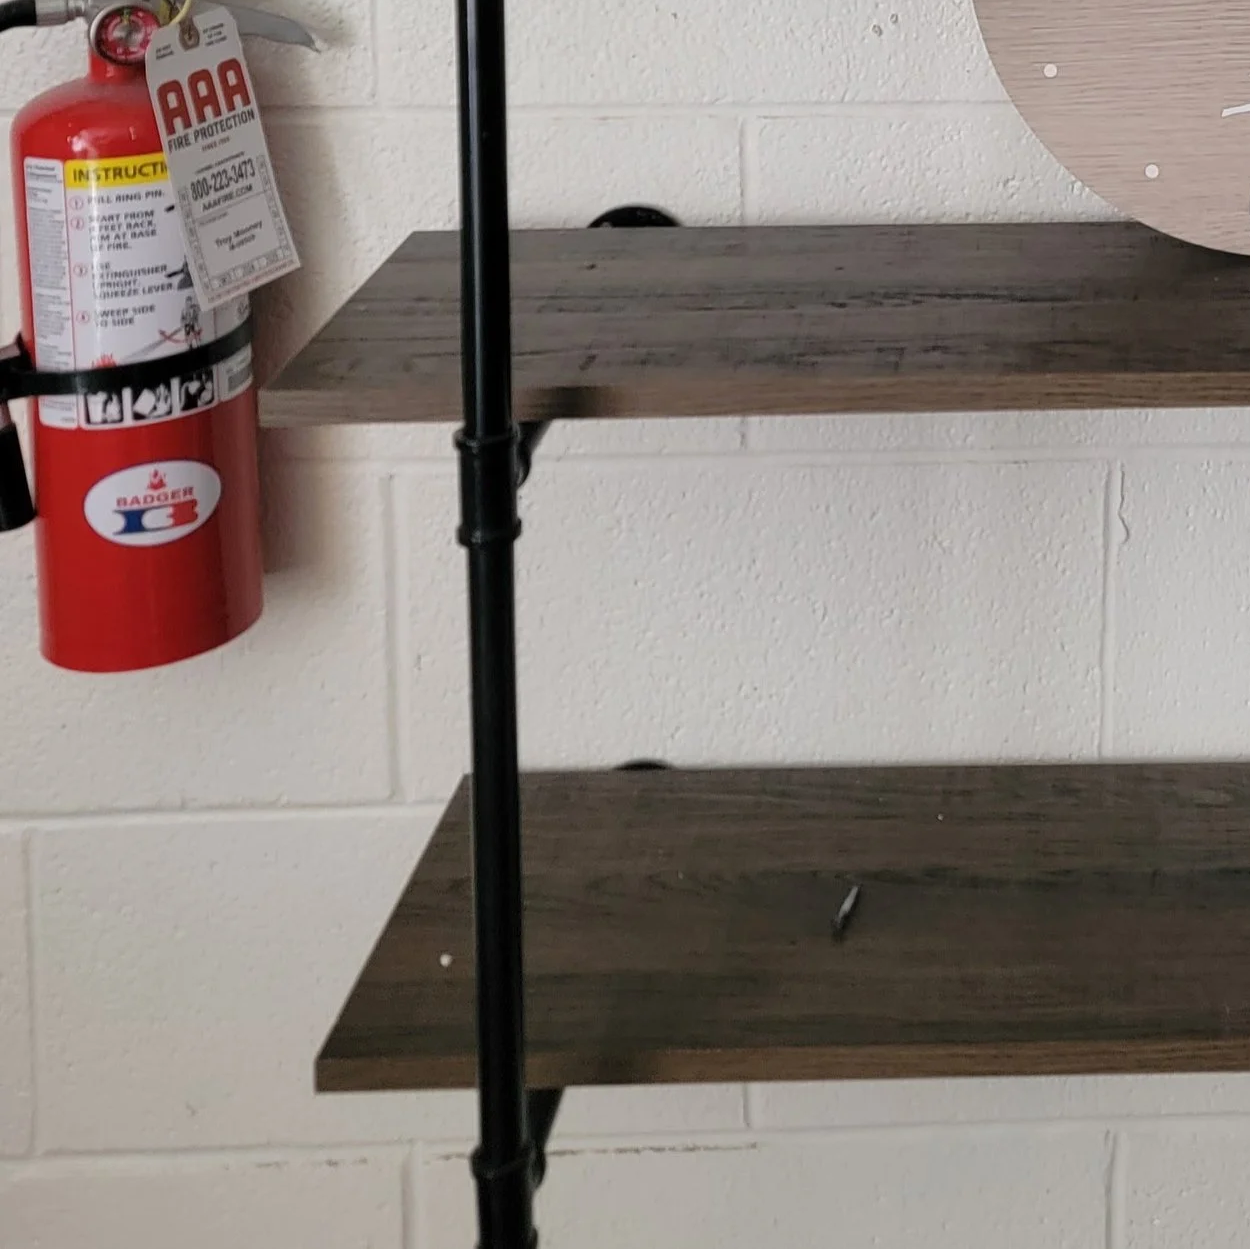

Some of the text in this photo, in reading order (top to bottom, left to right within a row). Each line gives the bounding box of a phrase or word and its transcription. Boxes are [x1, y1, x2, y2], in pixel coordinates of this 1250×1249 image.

[157, 57, 251, 136] AAA
[167, 108, 256, 153] FIRE PROTECTION
[73, 161, 168, 182] INSTRUCTI
[115, 191, 142, 203] RING
[88, 213, 120, 223] SART
[124, 210, 155, 220] FROM
[93, 289, 138, 300] QUEEZE
[116, 486, 194, 507] BADGER
